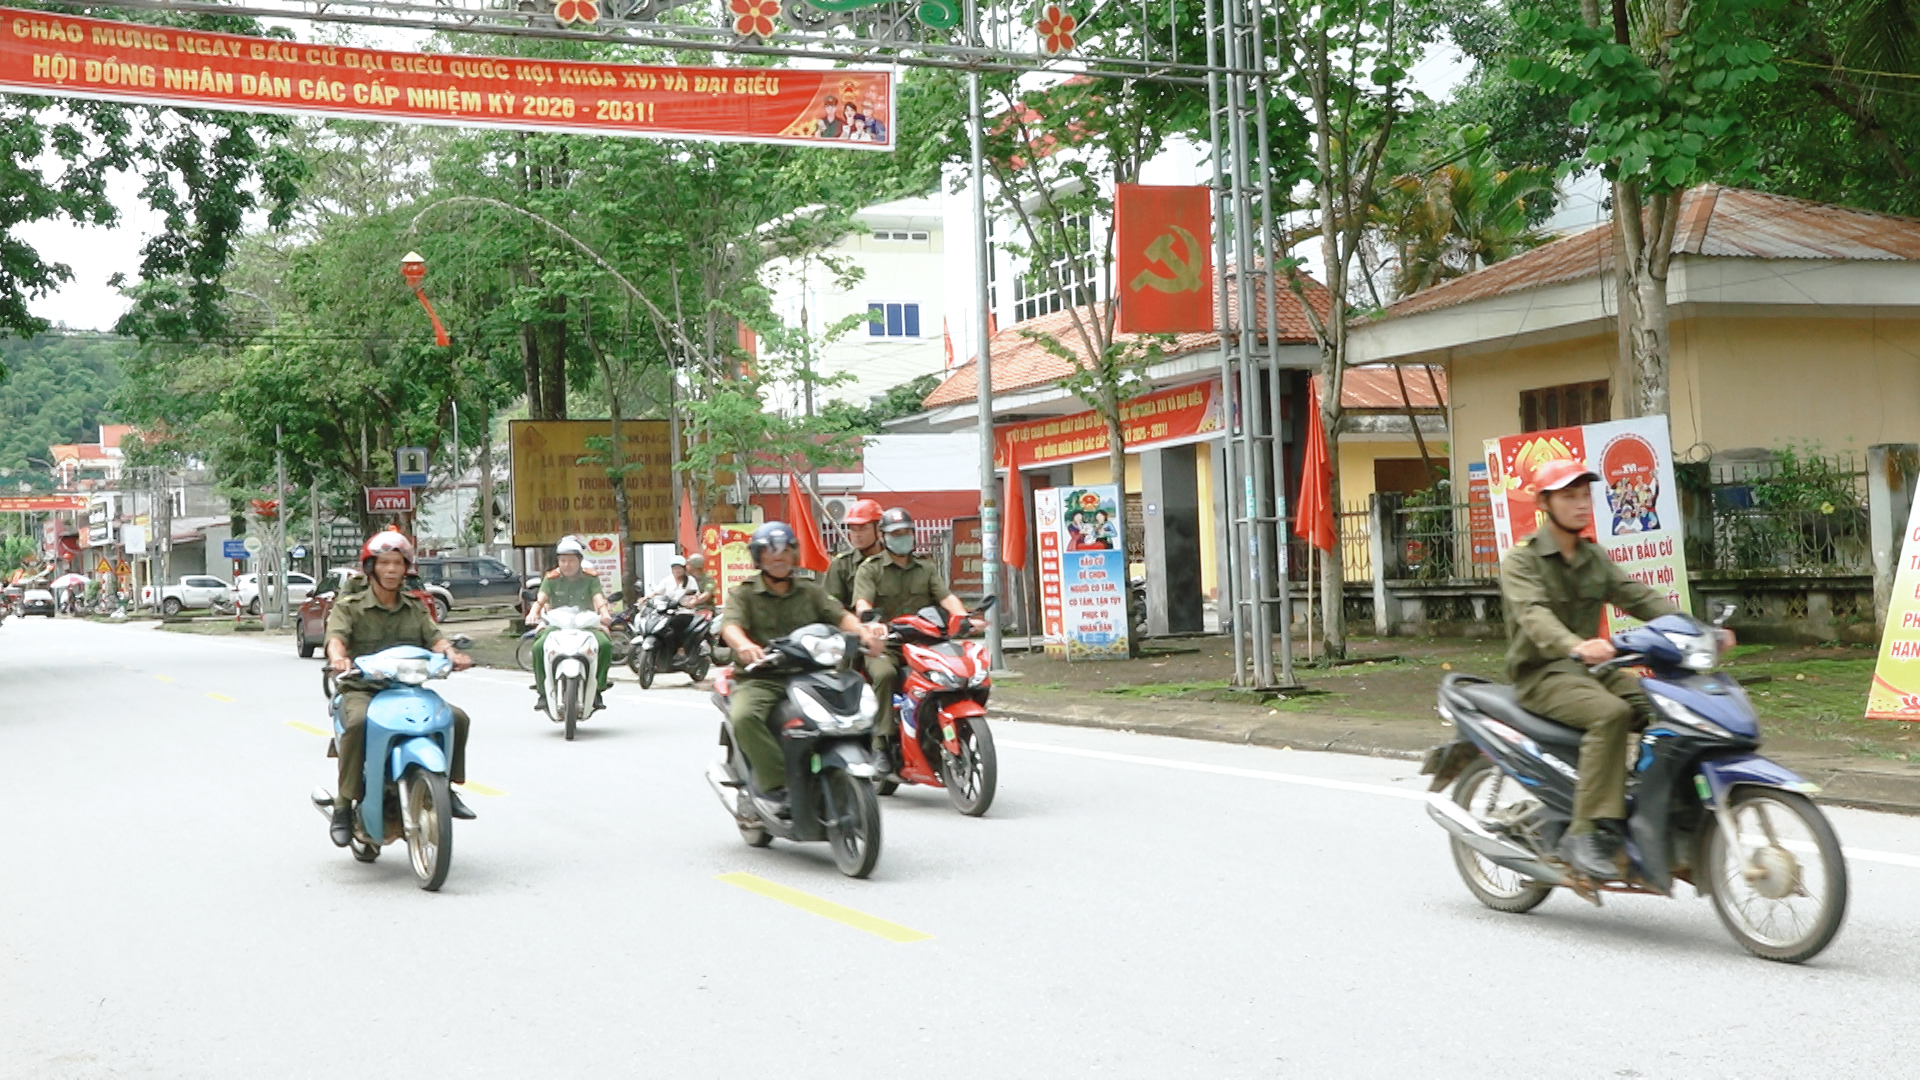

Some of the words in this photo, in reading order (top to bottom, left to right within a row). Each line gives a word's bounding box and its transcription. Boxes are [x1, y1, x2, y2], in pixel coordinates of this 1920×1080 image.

[33, 53, 77, 84] HỘI
[163, 65, 234, 94] NHÂN
[241, 71, 291, 98] DÂN
[299, 75, 346, 102] CÁC
[353, 77, 400, 106] CẤP
[406, 84, 482, 115] NHIỆM
[523, 95, 576, 118] 2026
[622, 71, 657, 91] XVI
[374, 498, 407, 509] ATM
[1607, 544, 1634, 562] NGÀY
[1658, 536, 1673, 557] CỬ
[1657, 564, 1674, 587] HỘI
